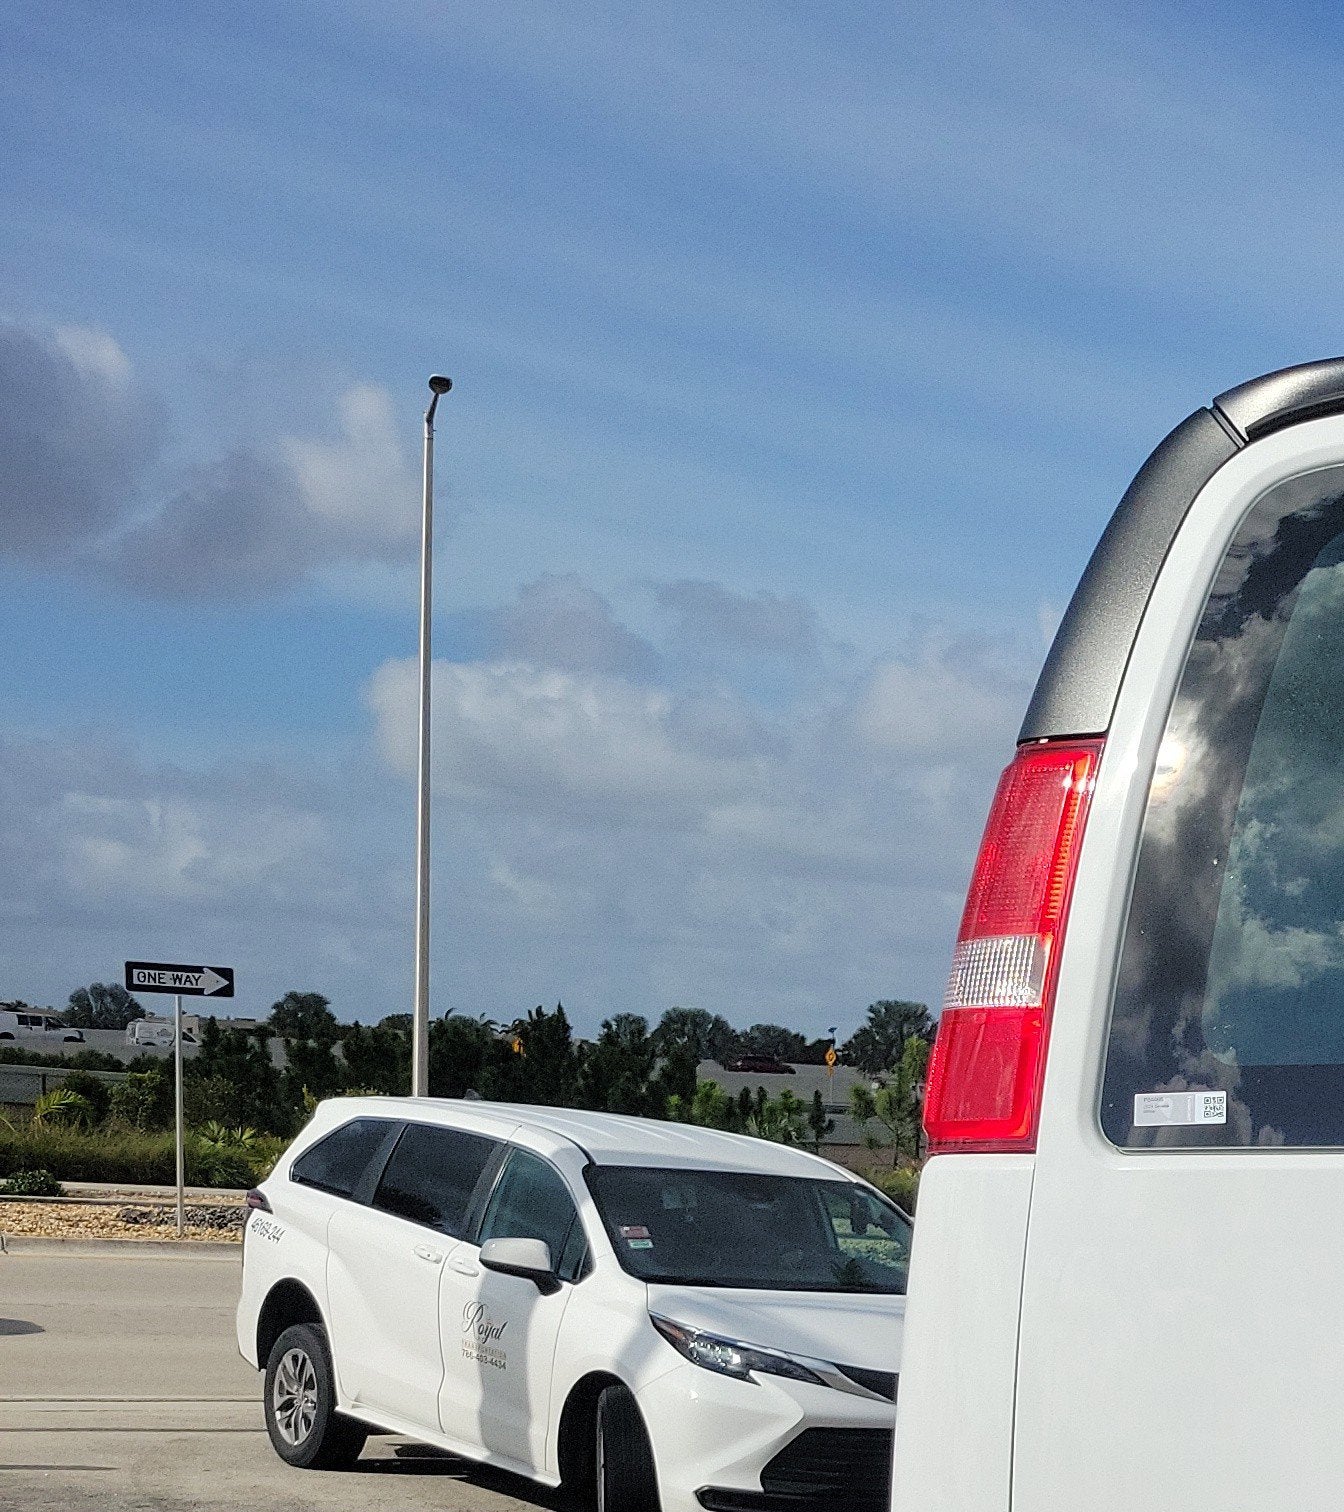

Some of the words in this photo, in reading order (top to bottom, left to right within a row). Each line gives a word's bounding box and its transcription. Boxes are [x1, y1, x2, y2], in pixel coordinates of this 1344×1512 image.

[137, 971, 166, 984] ONE
[172, 973, 202, 986] WAY
[462, 1300, 508, 1344] Royal
